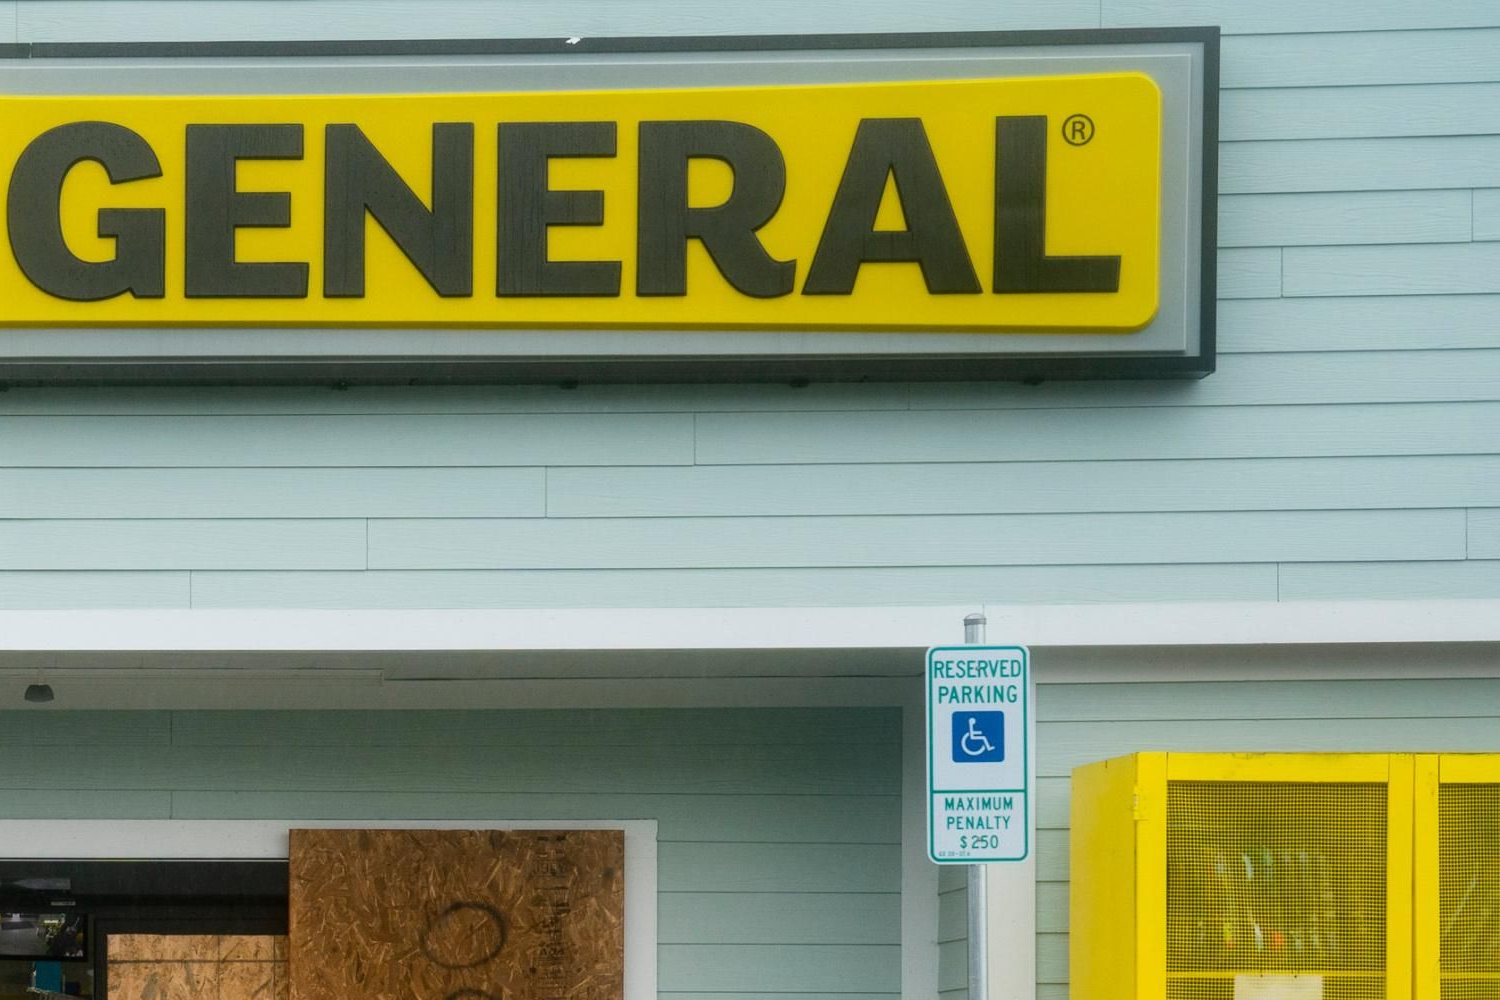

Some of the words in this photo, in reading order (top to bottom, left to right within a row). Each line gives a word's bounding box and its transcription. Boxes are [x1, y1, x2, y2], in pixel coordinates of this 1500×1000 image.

[934, 659, 1021, 679] RESERVED
[938, 685, 1018, 704] PARKING
[945, 797, 1013, 811] MAXIMUM
[946, 815, 1011, 830] PENALTY
